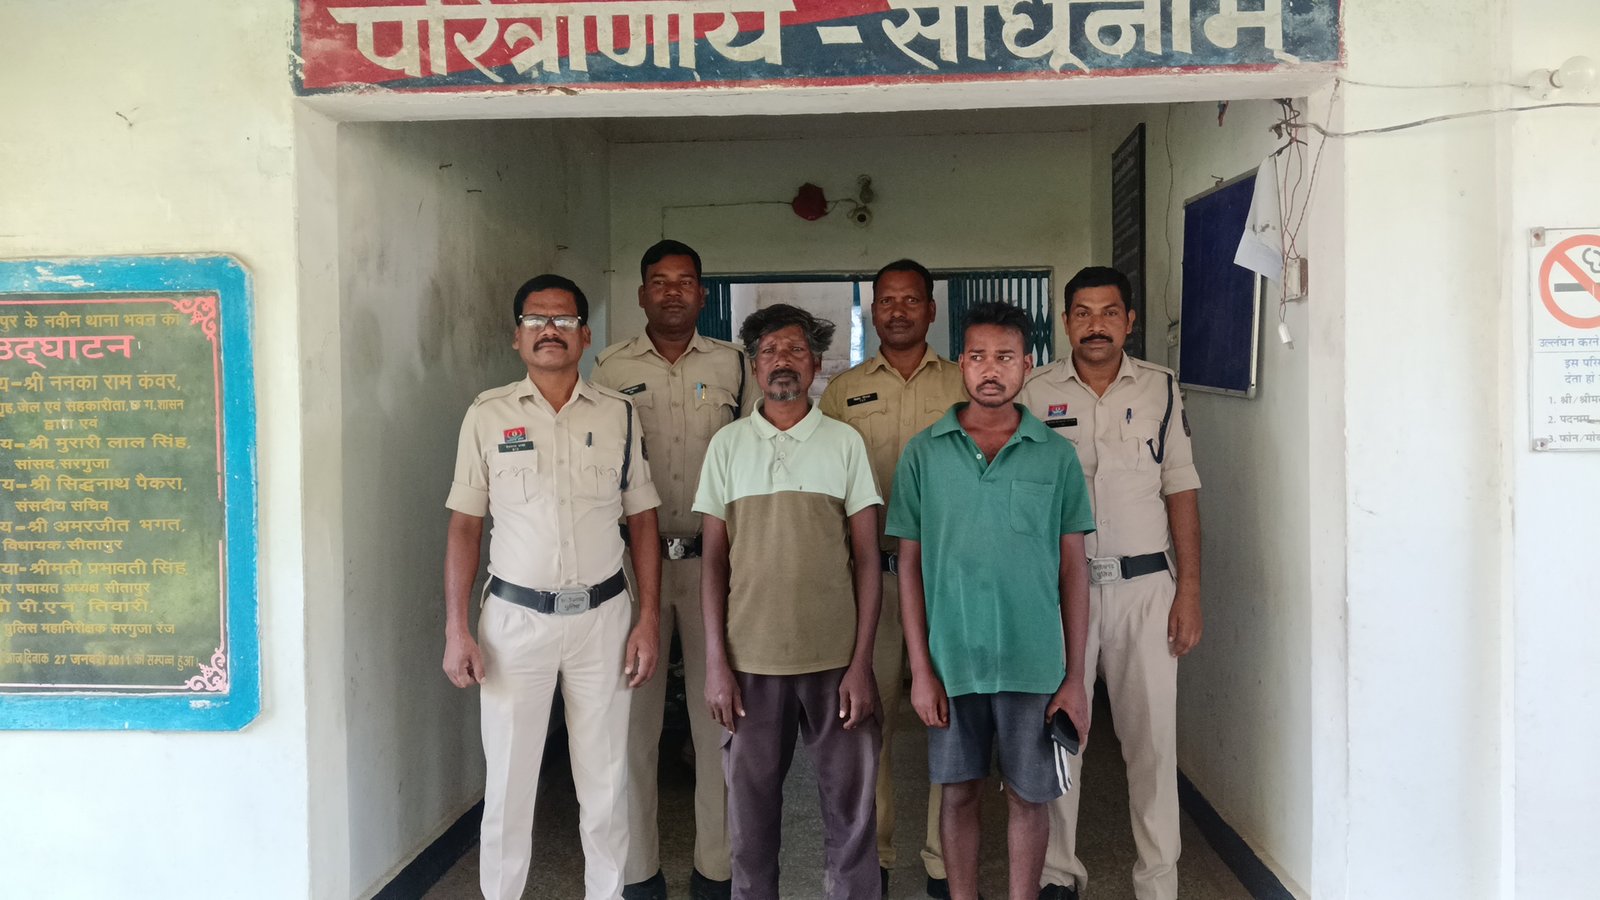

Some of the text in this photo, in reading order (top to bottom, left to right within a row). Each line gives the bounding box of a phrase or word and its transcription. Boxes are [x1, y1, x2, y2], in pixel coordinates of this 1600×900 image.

[326, 0, 796, 82] परित्राणाय
[24, 311, 38, 328] के
[44, 311, 81, 328] नवीन
[86, 314, 119, 327] थाना
[124, 314, 156, 327] भवन
[161, 313, 180, 326] का
[1577, 334, 1600, 346] करने
[1564, 358, 1579, 369] इस
[49, 375, 97, 391] ननका
[103, 374, 132, 391] राम
[44, 398, 61, 414] एवं
[1548, 396, 1557, 405] 1.
[79, 416, 98, 429] एवं
[1547, 415, 1557, 424] 2.
[55, 434, 101, 453] मुरारी
[106, 437, 146, 449] लाल
[56, 474, 130, 492] सिद्धनाथ
[71, 497, 109, 512] सचिव
[54, 516, 130, 533] अमरजीत
[87, 559, 147, 575] प्रभावती
[104, 580, 151, 597] सीतापुर
[41, 620, 107, 634] महानिरीक्षक
[111, 623, 152, 638] सरगुजा
[54, 654, 67, 665] 27
[70, 652, 105, 666] जनवरी
[108, 654, 130, 665] 2011
